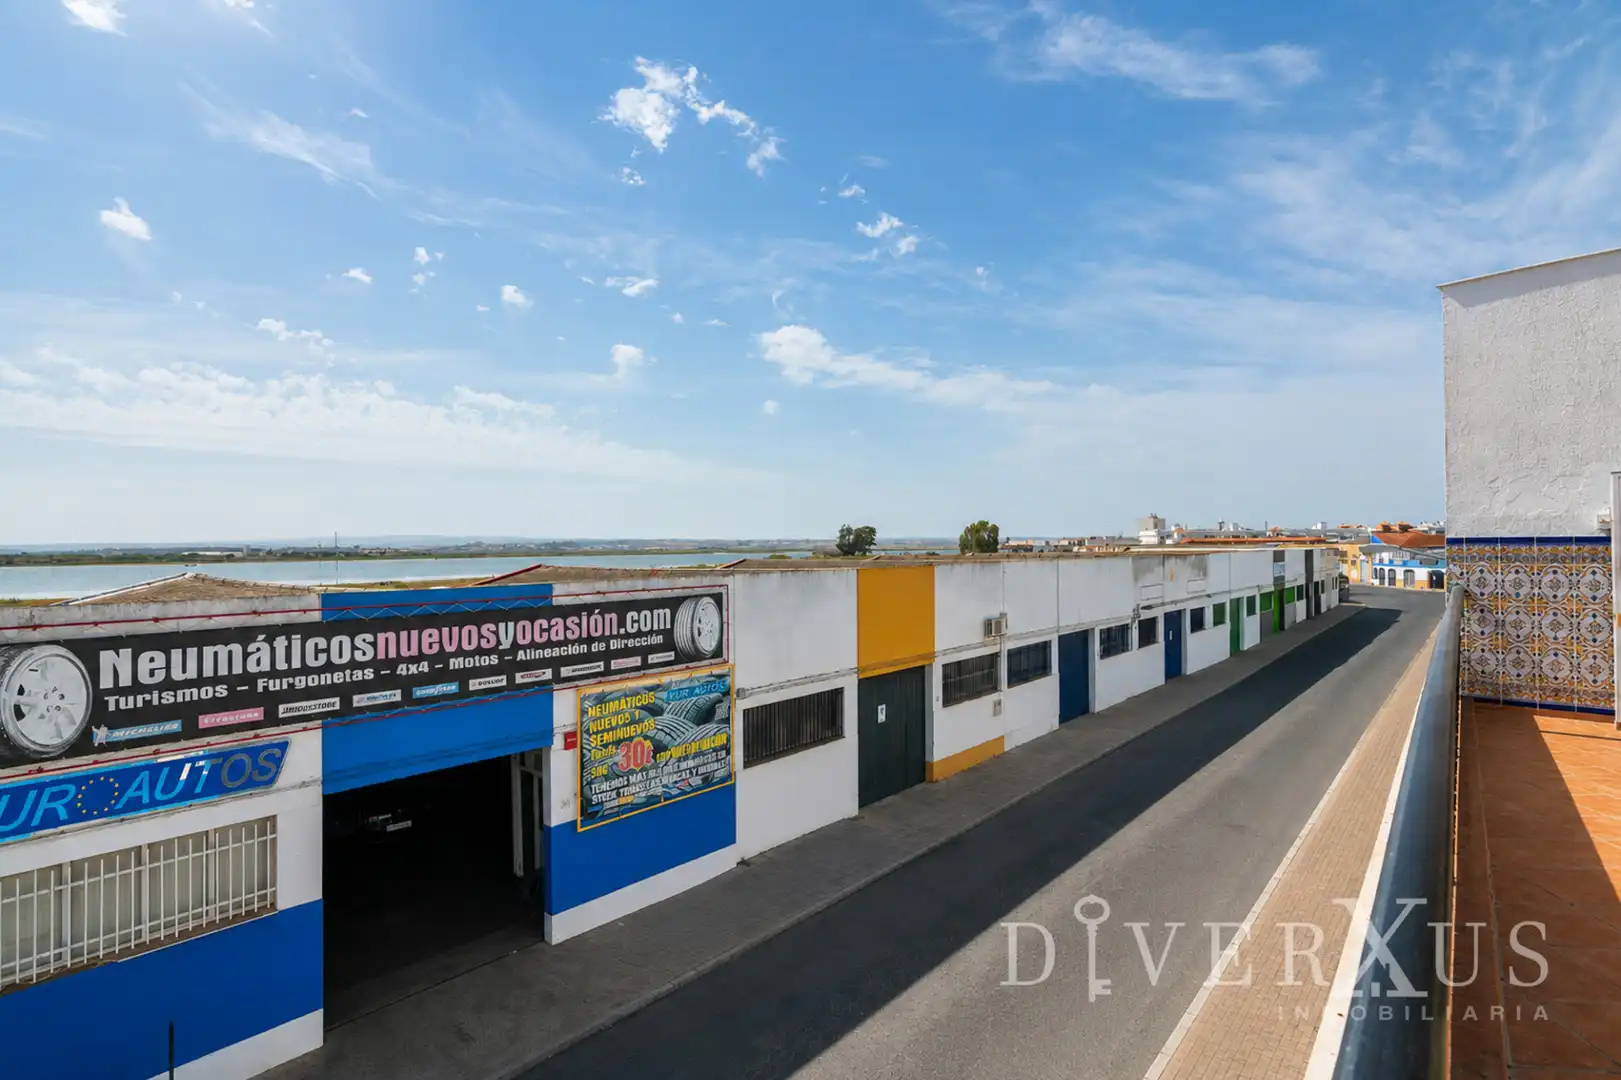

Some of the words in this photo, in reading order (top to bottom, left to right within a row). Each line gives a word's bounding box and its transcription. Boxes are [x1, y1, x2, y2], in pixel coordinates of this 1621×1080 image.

[99, 607, 672, 690] Neumáticosnuevosyocasión.com
[104, 685, 229, 712] Turismos
[257, 667, 375, 694] Furgonetas
[396, 660, 430, 677] 4x4
[449, 653, 500, 671] Motos
[516, 642, 589, 662] Alineación
[591, 639, 607, 653] de
[609, 632, 664, 651] Dirección
[589, 712, 631, 734] NUEVOS
[590, 718, 655, 748] SEMINUEVOS
